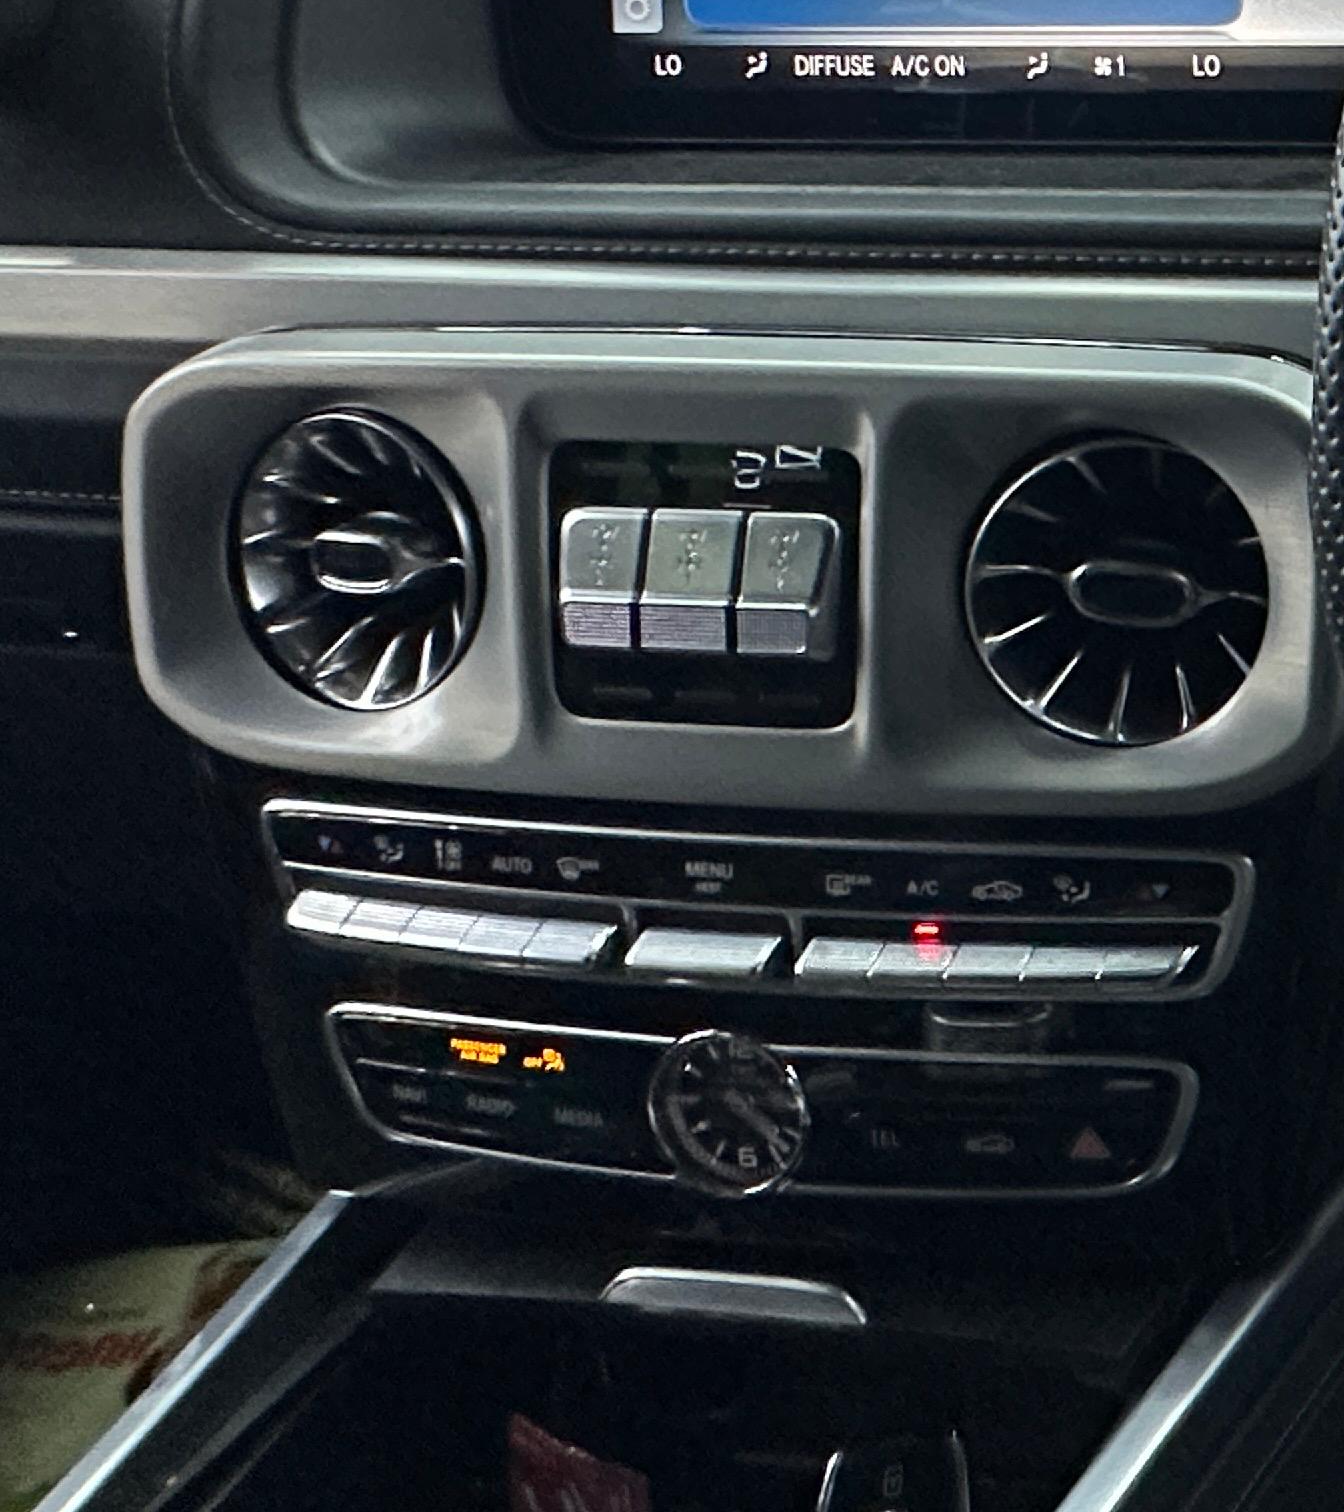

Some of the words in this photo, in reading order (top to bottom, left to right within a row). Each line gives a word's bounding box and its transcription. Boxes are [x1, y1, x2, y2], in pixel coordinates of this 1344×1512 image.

[654, 53, 683, 76] LO
[794, 54, 876, 77] DIFFUSE
[890, 54, 931, 77] A/C
[934, 54, 966, 77] ON
[1116, 54, 1127, 77] 1
[1192, 53, 1222, 78] LO
[490, 856, 533, 875] AUTO
[684, 861, 735, 880] MENU
[906, 880, 940, 898] A/C
[737, 1146, 758, 1168] 6
